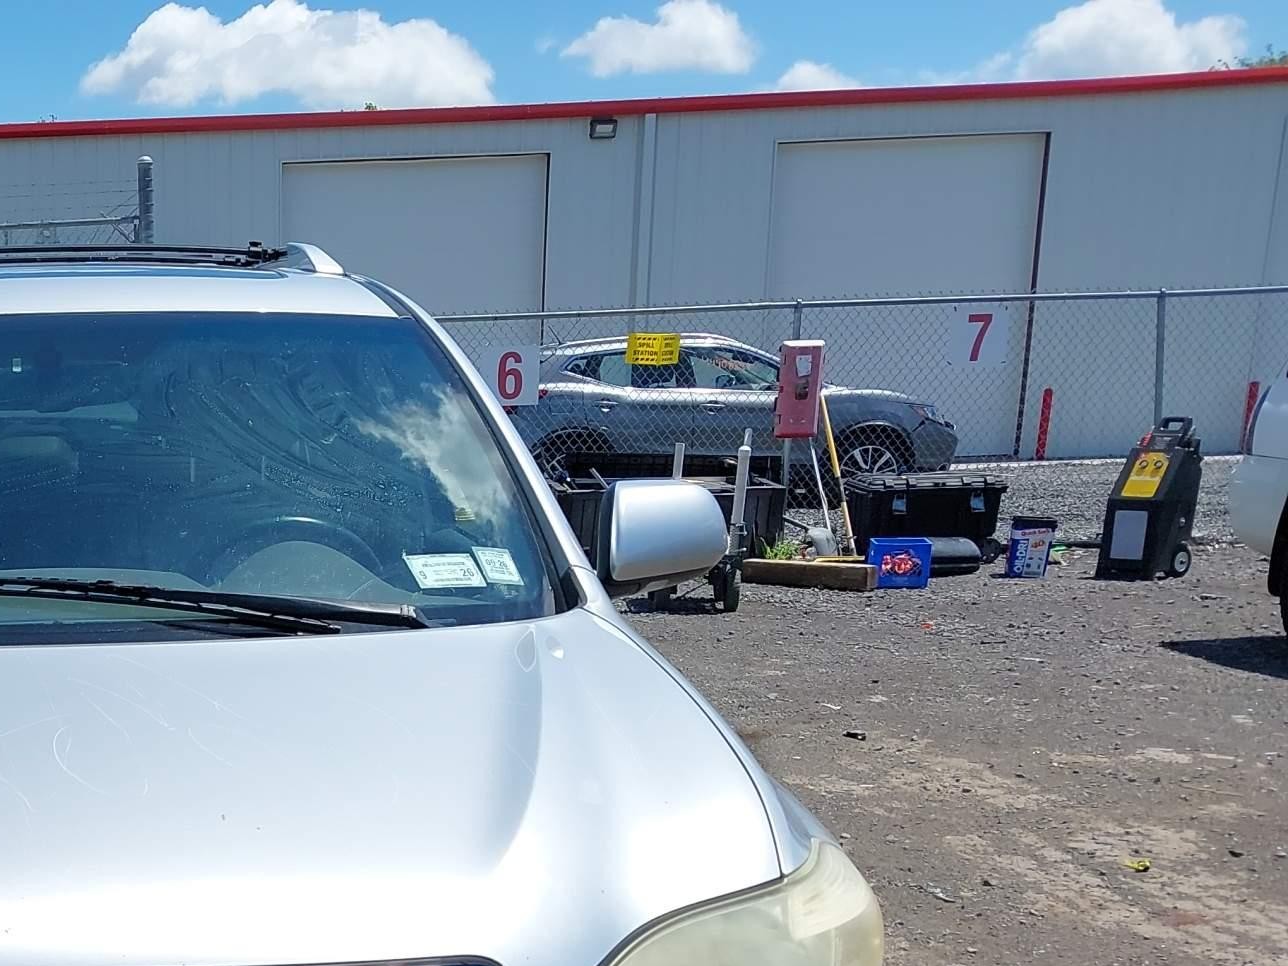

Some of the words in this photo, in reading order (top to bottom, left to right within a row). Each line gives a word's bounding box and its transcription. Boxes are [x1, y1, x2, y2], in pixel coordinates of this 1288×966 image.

[968, 313, 993, 361] 7
[498, 351, 522, 400] 6
[459, 567, 475, 577] 26
